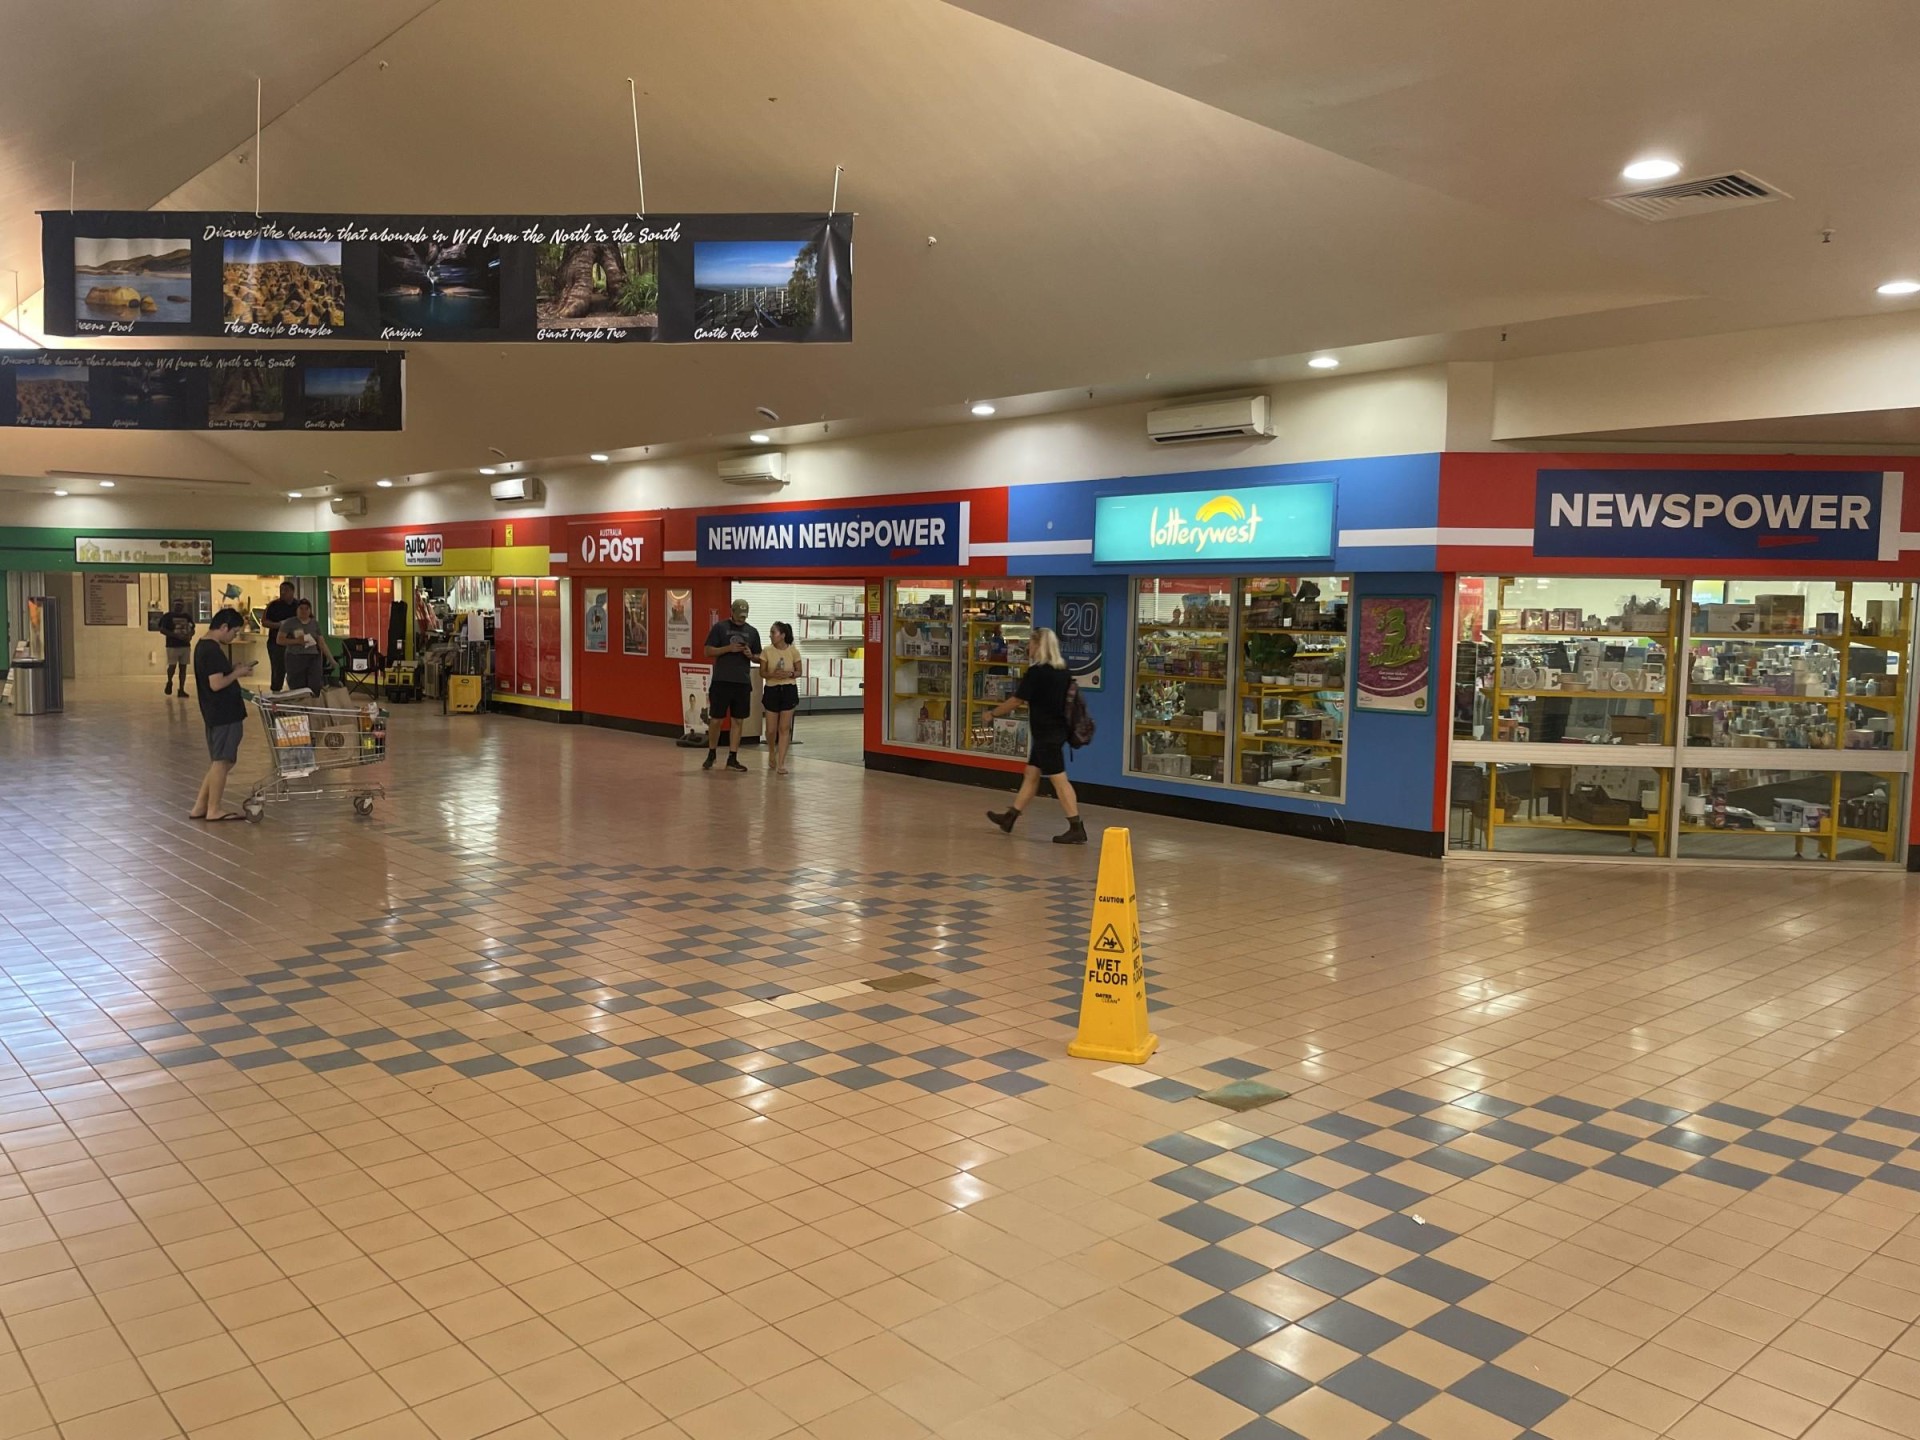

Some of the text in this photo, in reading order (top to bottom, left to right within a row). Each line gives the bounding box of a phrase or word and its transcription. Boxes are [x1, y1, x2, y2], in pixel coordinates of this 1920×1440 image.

[203, 220, 681, 248] Dicover the beauty that abounds in WA from the North to the South
[108, 320, 136, 333] Pool
[224, 318, 333, 338] The Bungle Bungles
[380, 326, 423, 341] Karijini
[537, 326, 627, 341] Giant Tingle Tree
[694, 325, 759, 341] Castle Rock
[85, 354, 106, 366] that
[145, 358, 155, 367] in
[156, 358, 173, 368] WA
[175, 356, 198, 371] from
[200, 355, 214, 368] the
[216, 355, 241, 368] North
[243, 358, 252, 368] to
[254, 355, 266, 368] the
[268, 355, 296, 368] South
[1550, 492, 1872, 531] NEWSPOWER
[599, 528, 622, 537] AUSTRALIA
[708, 517, 946, 551] NEWMAN NEWSPOWER
[1150, 503, 1263, 553] lotterywest
[406, 537, 442, 557] autopro
[600, 537, 644, 563] POST
[1062, 602, 1098, 637] 20
[1098, 895, 1125, 904] CAUTION
[1096, 957, 1121, 972] WET
[1088, 970, 1128, 986] FLOOR
